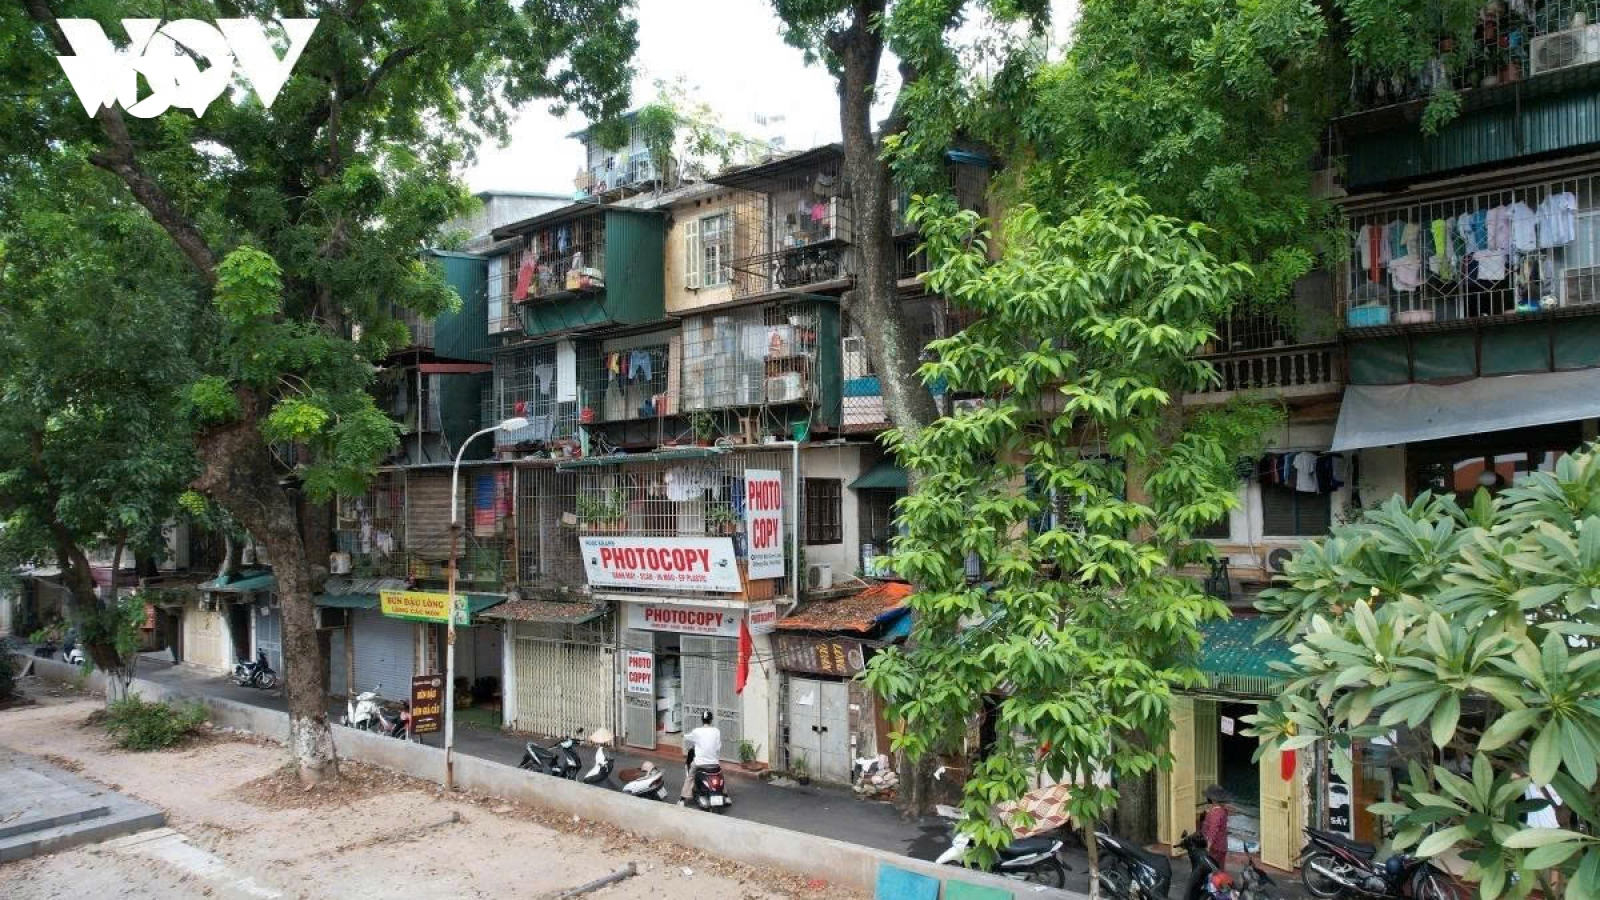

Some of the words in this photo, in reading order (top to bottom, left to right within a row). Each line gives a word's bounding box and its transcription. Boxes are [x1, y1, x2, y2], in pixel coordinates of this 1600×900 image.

[748, 481, 781, 511] PHOTO
[753, 518, 779, 549] COPY
[600, 547, 710, 572] PHOTOCOPY
[645, 608, 724, 628] PHOTOCOPY
[628, 656, 651, 669] PHOTO
[628, 671, 651, 684] COPPY
